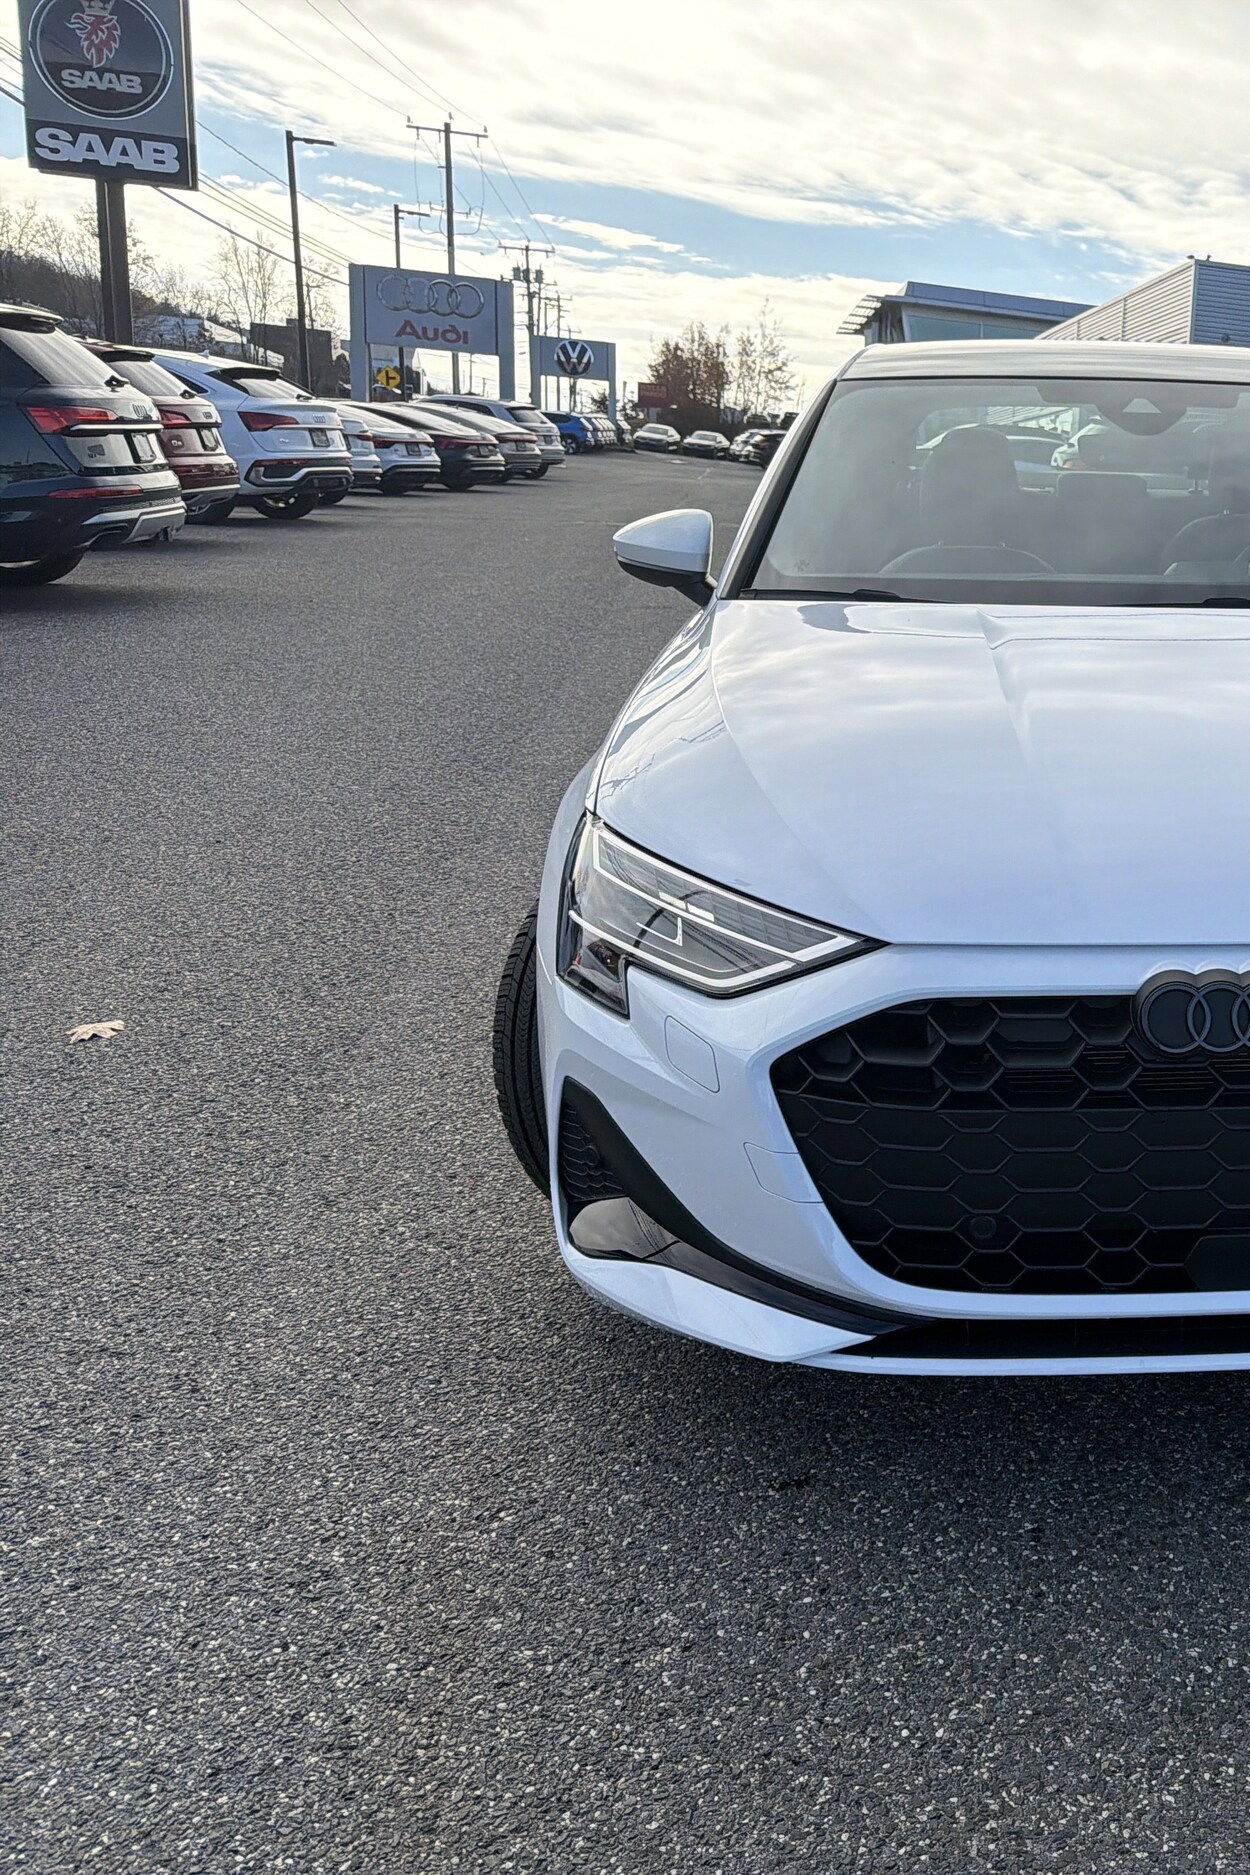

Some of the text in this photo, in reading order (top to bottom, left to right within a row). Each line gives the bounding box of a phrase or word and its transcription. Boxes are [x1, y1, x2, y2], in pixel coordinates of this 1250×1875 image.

[61, 69, 143, 94] SAAB
[34, 127, 180, 174] SAAB
[394, 319, 469, 345] Audi
